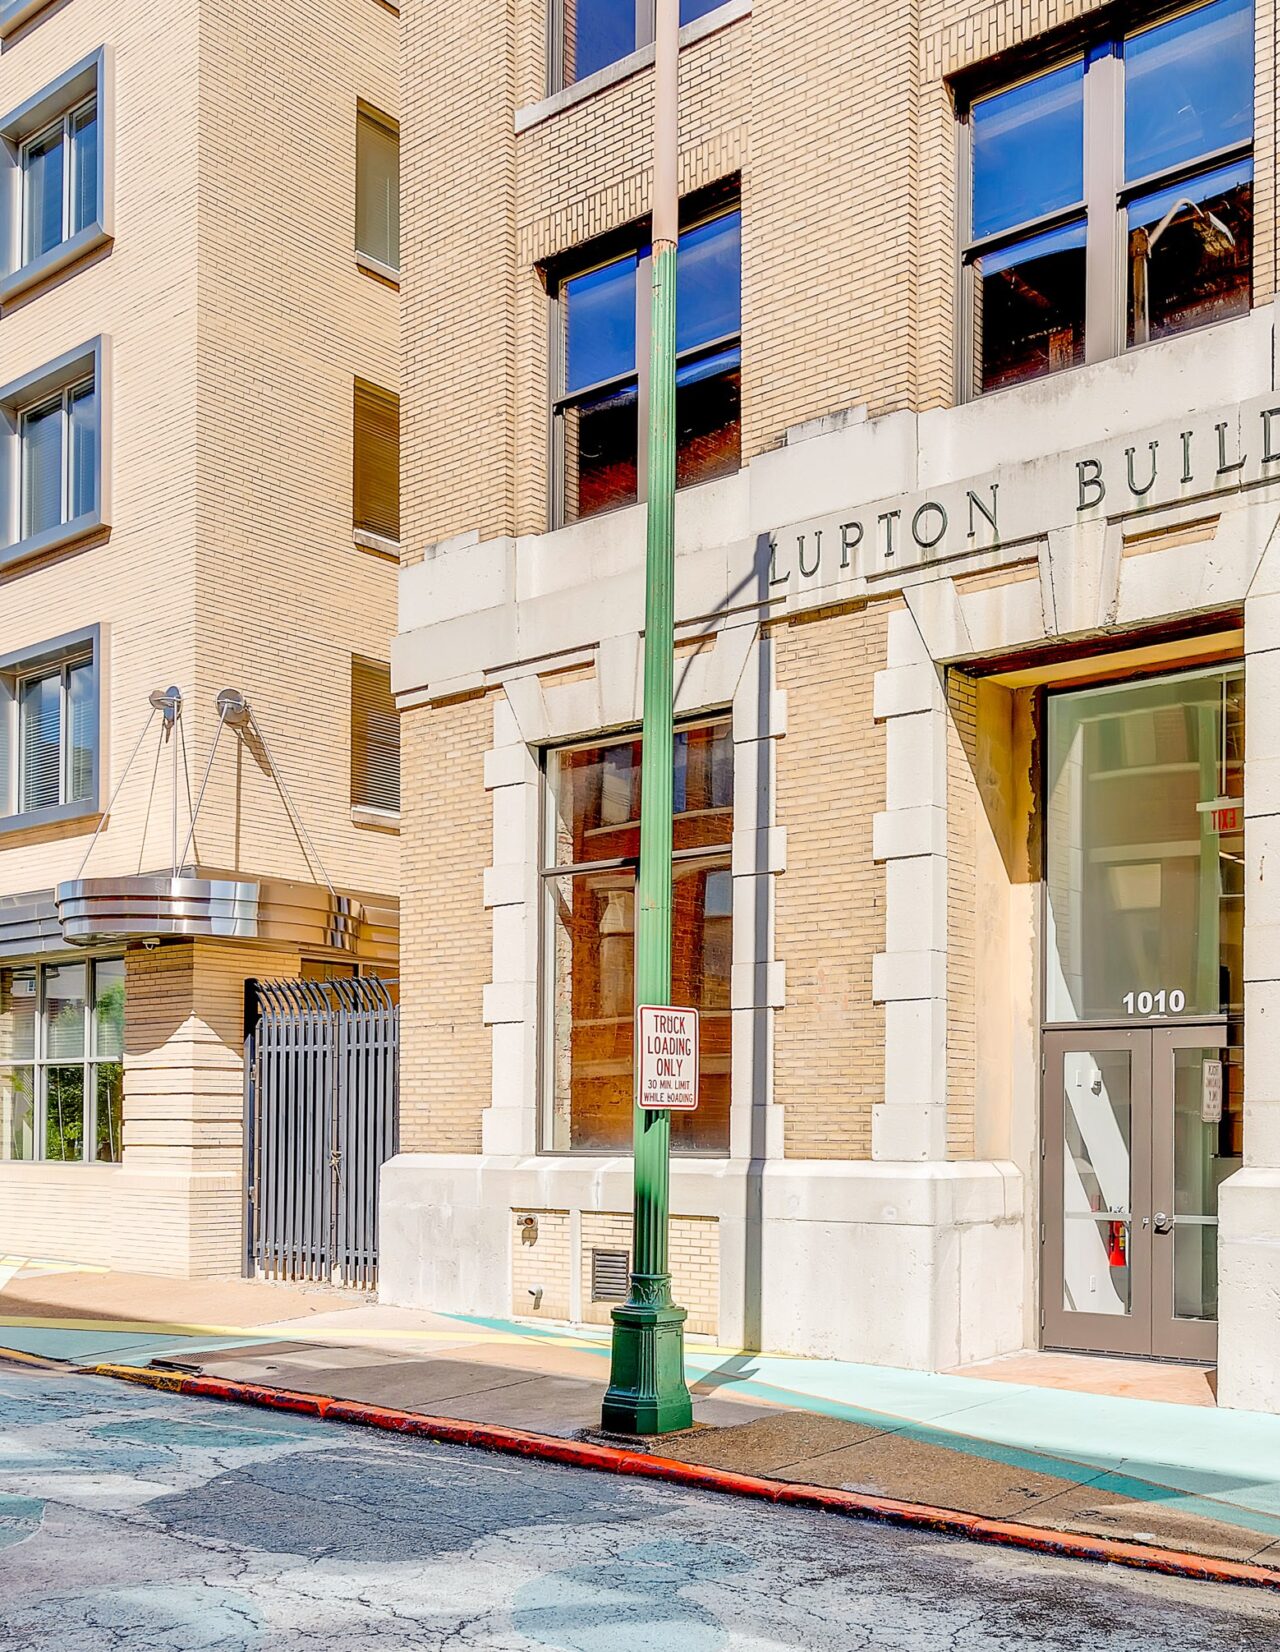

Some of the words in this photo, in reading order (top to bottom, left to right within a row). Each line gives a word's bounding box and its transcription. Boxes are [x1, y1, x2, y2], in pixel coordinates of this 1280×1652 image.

[769, 483, 999, 586] LUPTON
[1122, 989, 1185, 1014] 1010
[653, 1014, 686, 1035] TRUCK
[647, 1036, 692, 1056] LOADING
[656, 1058, 683, 1077] ONLY
[647, 1079, 658, 1089] 30
[660, 1080, 673, 1090] MIN.
[674, 1080, 690, 1090] LIMIT
[643, 1092, 665, 1102] WHILE
[667, 1093, 693, 1103] LOADING
